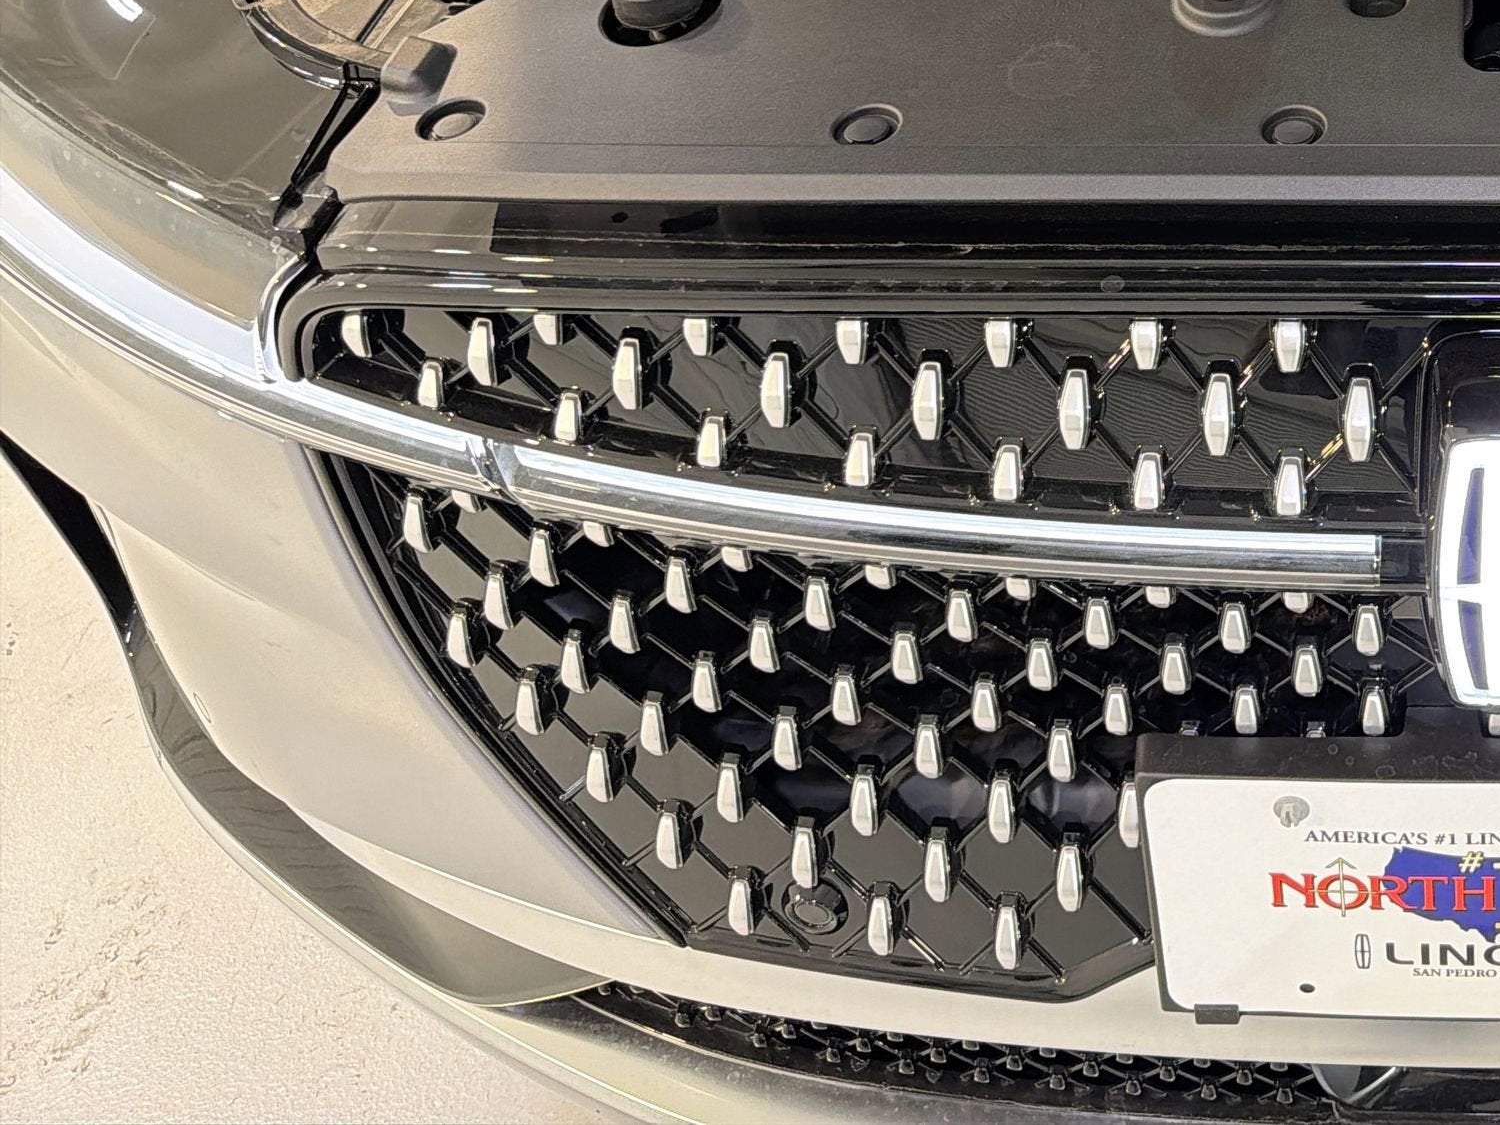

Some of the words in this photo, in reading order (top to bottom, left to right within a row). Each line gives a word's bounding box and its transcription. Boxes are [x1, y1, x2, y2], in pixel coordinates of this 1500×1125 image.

[1304, 830, 1428, 845] AMERICA'S
[1434, 831, 1456, 845] #1
[1268, 872, 1496, 911] NORTH
[1412, 967, 1442, 977] SAN
[1445, 968, 1498, 978] PEDRO
